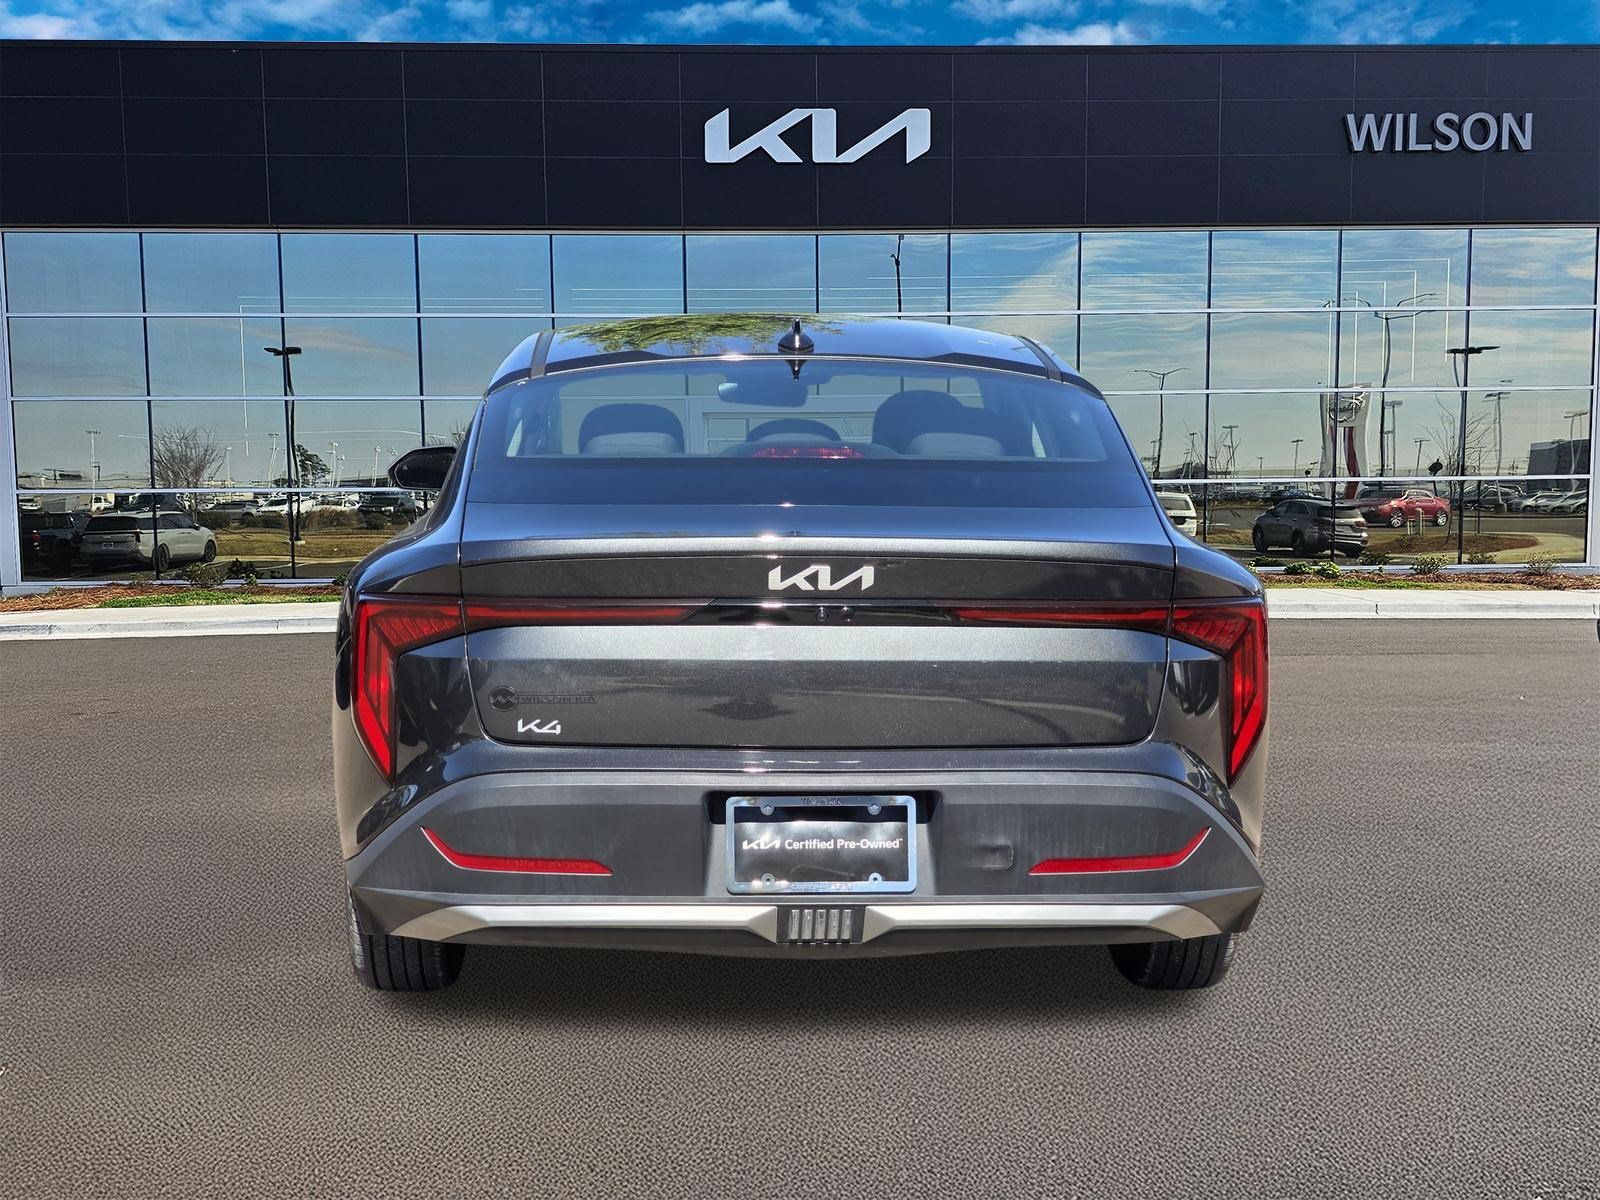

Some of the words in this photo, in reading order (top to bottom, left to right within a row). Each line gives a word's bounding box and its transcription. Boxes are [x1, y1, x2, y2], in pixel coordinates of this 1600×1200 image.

[705, 107, 931, 164] KIA
[1345, 111, 1534, 152] WILSON
[768, 565, 875, 591] KIA
[522, 695, 571, 704] WILSON
[517, 718, 561, 735] K4
[742, 839, 780, 850] KIA
[784, 838, 834, 850] Certified
